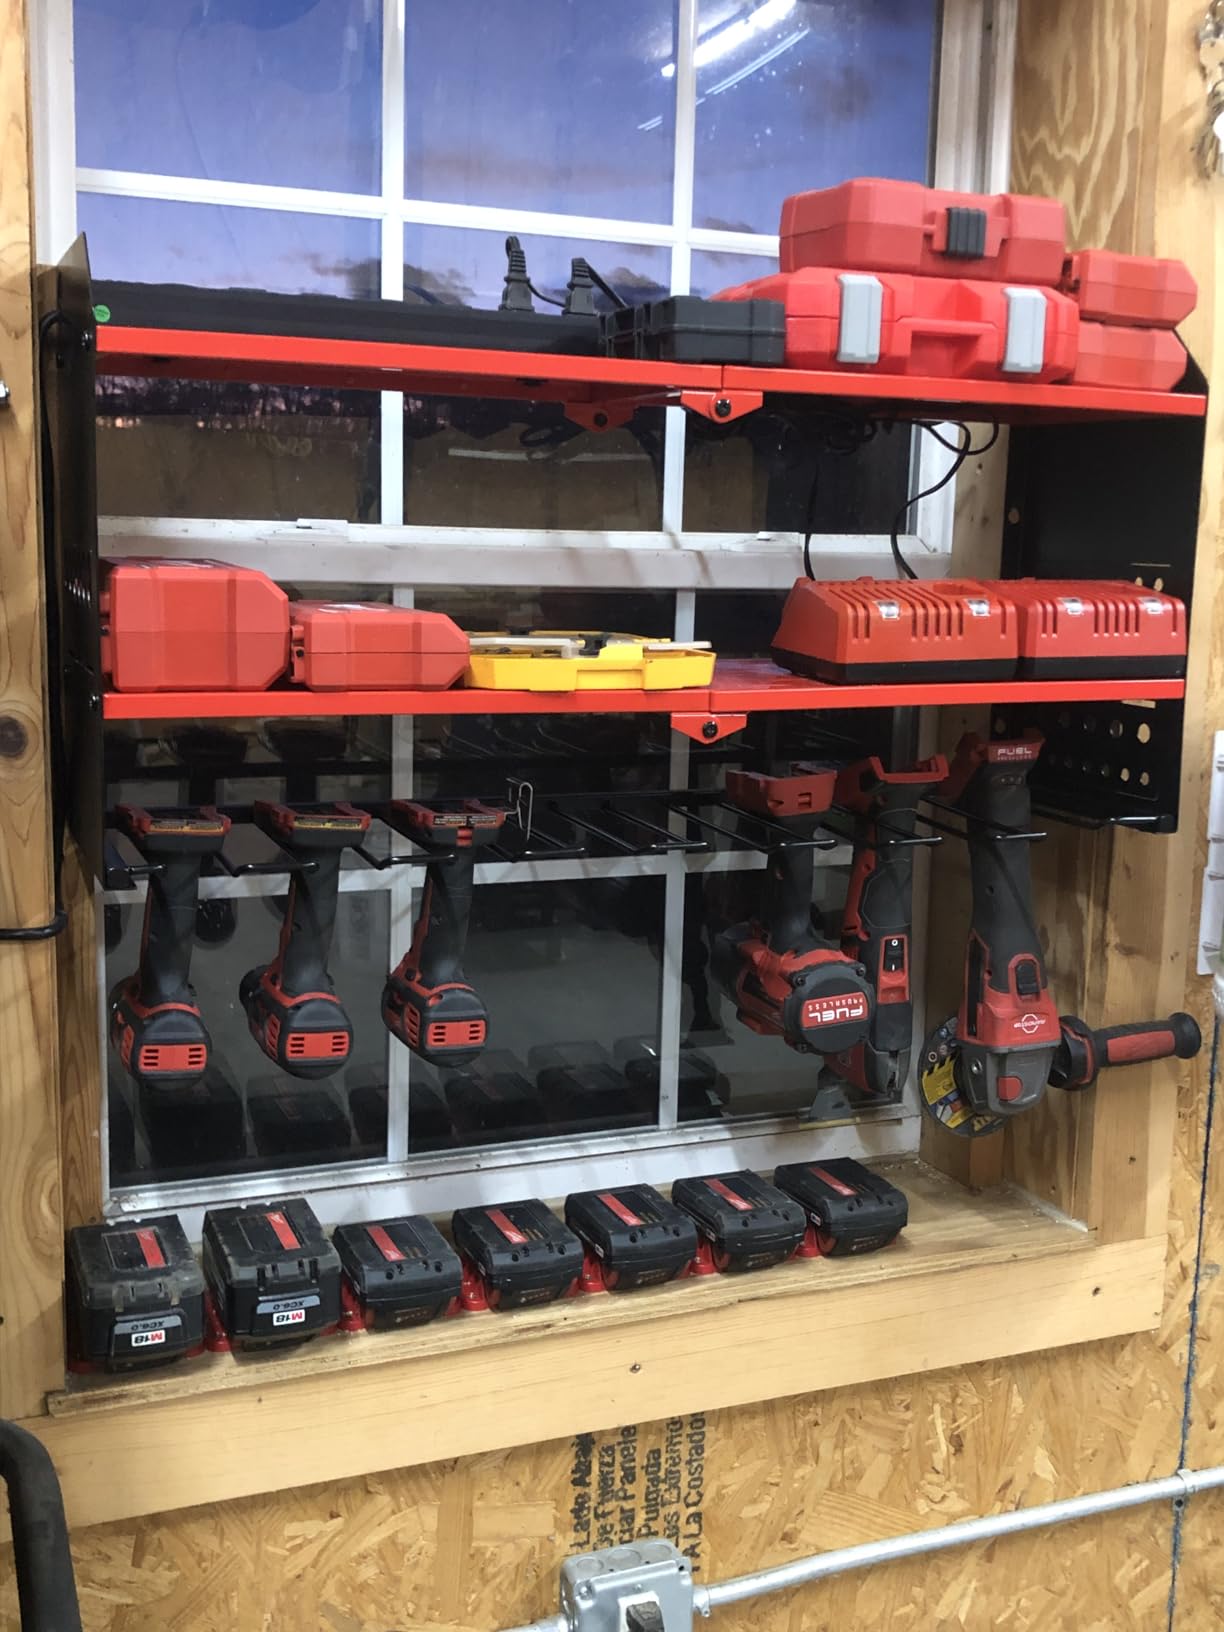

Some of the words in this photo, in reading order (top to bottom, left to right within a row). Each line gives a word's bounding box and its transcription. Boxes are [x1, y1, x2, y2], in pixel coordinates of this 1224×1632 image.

[998, 747, 1033, 756] FUEL
[808, 1004, 864, 1023] FUEL
[275, 1311, 304, 1323] M18
[134, 1331, 163, 1344] M18
[614, 1425, 637, 1501] Panele
[636, 1448, 661, 1538] Pulgada
[614, 1507, 635, 1545] ciar
